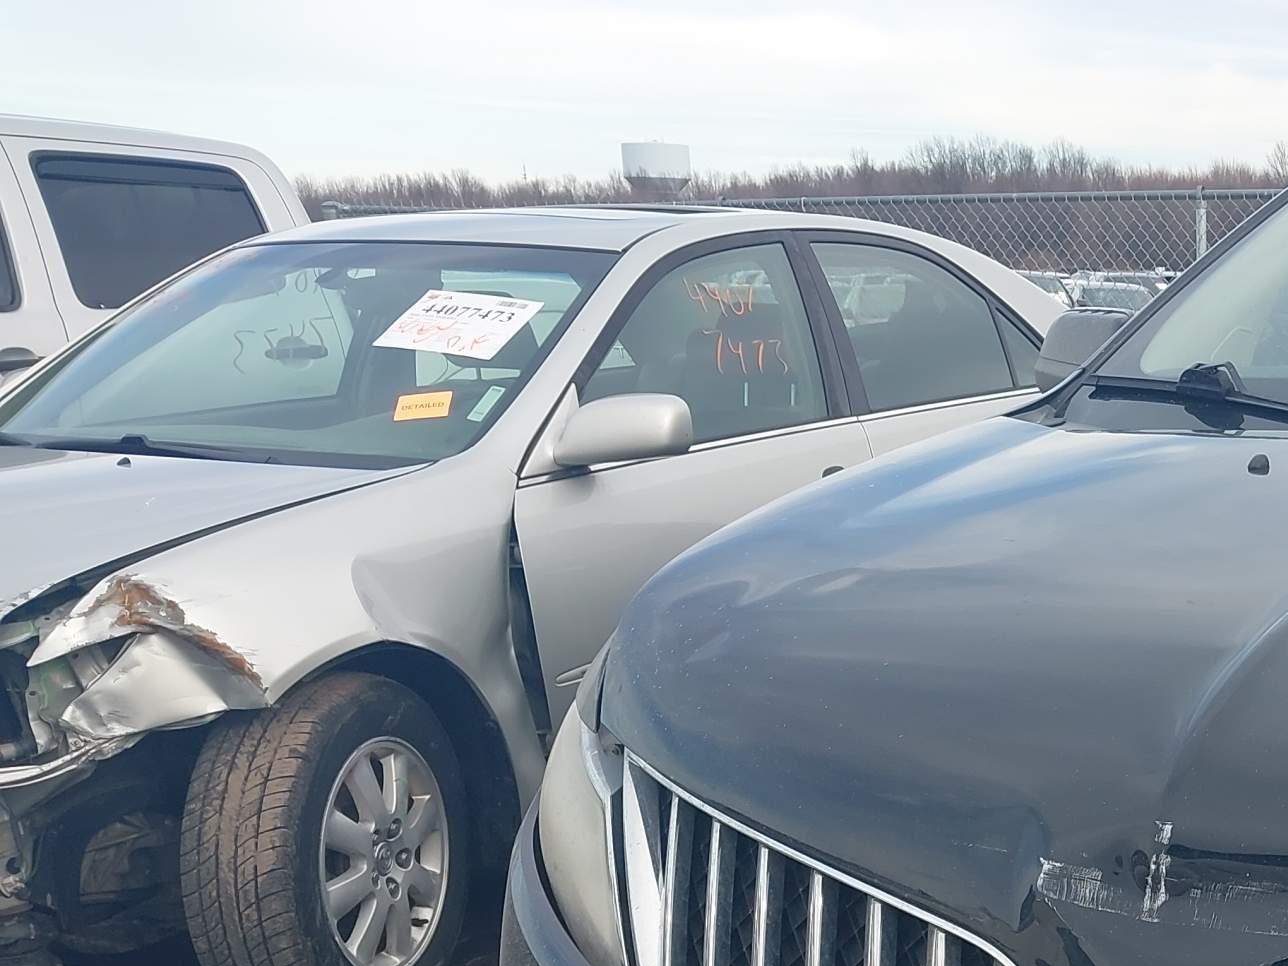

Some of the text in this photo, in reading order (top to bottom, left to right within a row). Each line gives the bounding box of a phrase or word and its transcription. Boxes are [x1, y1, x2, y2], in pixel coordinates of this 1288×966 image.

[422, 303, 516, 323] 44077473
[702, 328, 789, 375] 7473
[400, 401, 445, 411] DETAILED
